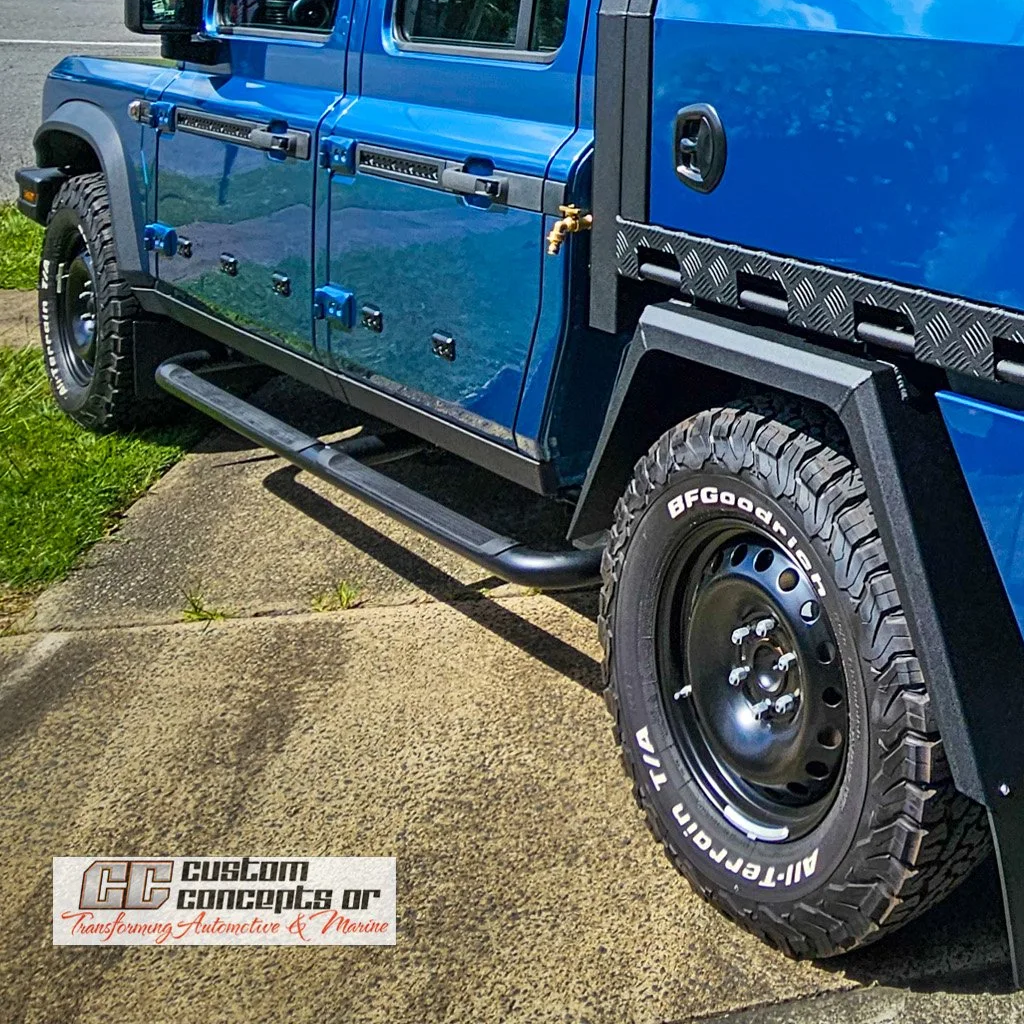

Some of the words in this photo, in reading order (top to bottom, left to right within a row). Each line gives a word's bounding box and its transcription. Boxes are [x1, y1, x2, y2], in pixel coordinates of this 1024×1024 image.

[667, 487, 827, 597] BFGoodrich
[635, 725, 668, 792] T/A
[671, 802, 819, 888] All-Terrain
